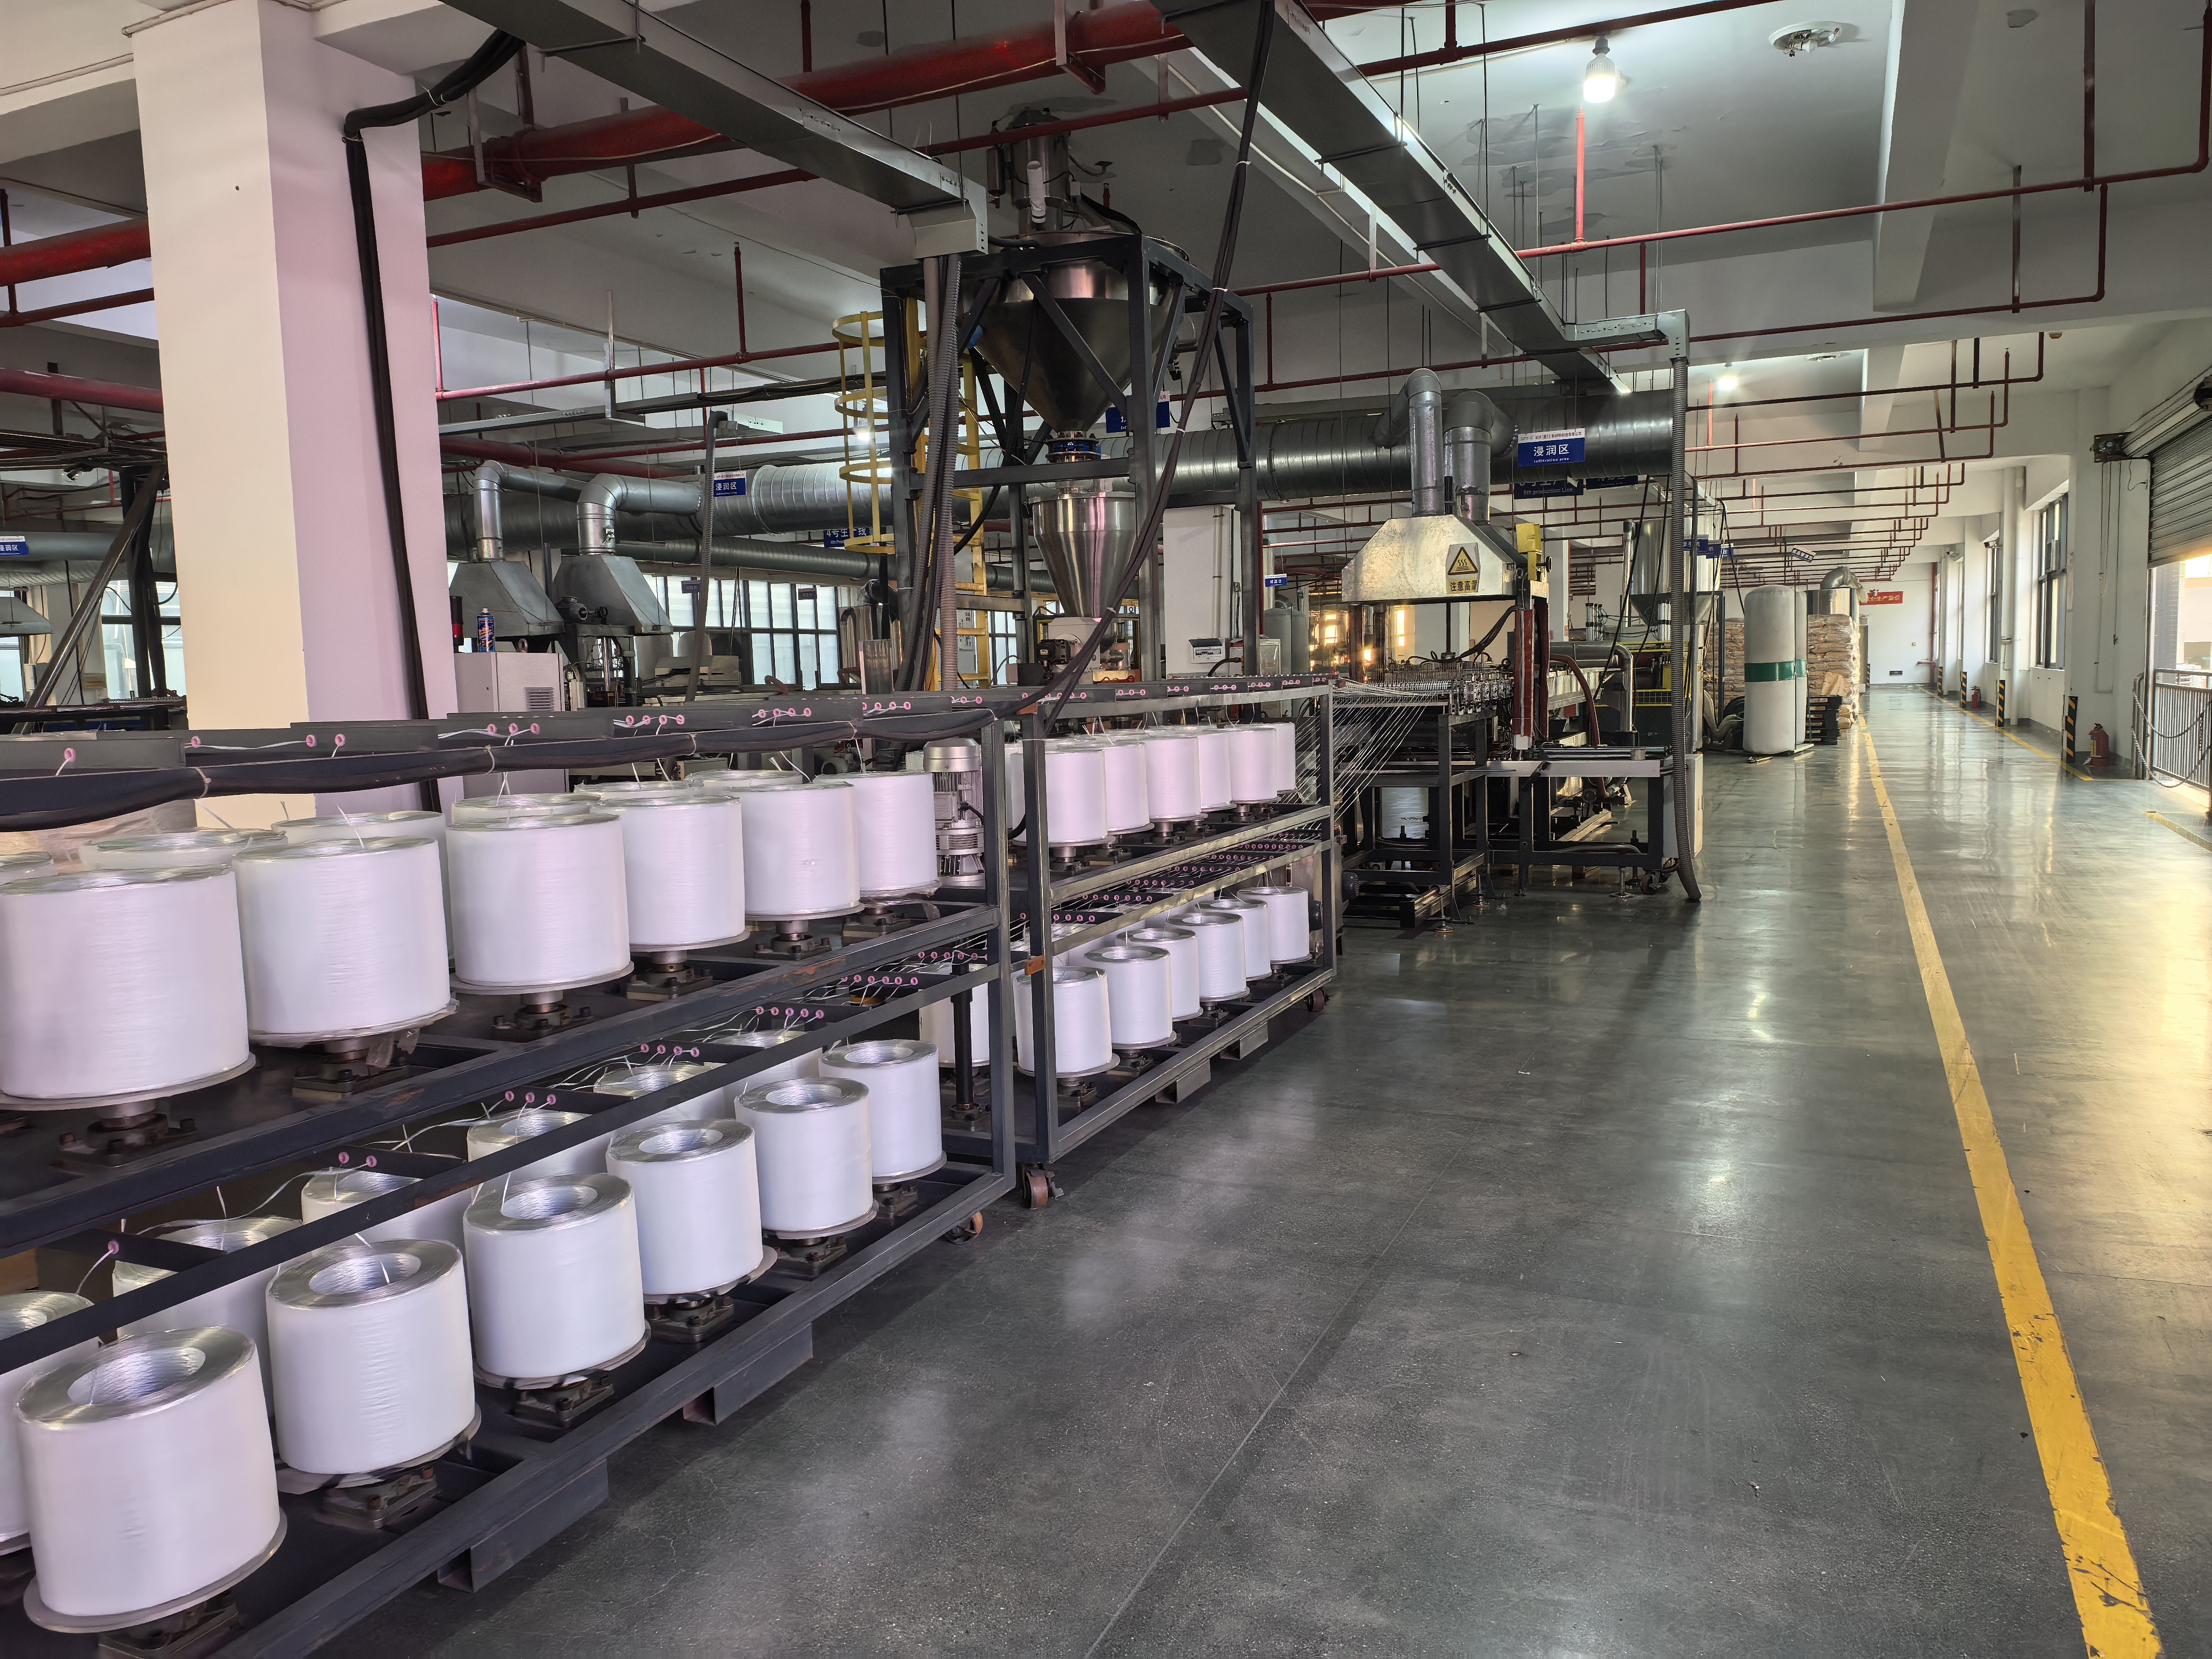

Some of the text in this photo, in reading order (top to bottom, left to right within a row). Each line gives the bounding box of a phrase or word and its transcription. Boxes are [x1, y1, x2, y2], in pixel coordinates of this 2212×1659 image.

[1533, 444, 1569, 457] 浸润区
[826, 528, 867, 538] 4号生线
[1450, 580, 1477, 591] 注意高温
